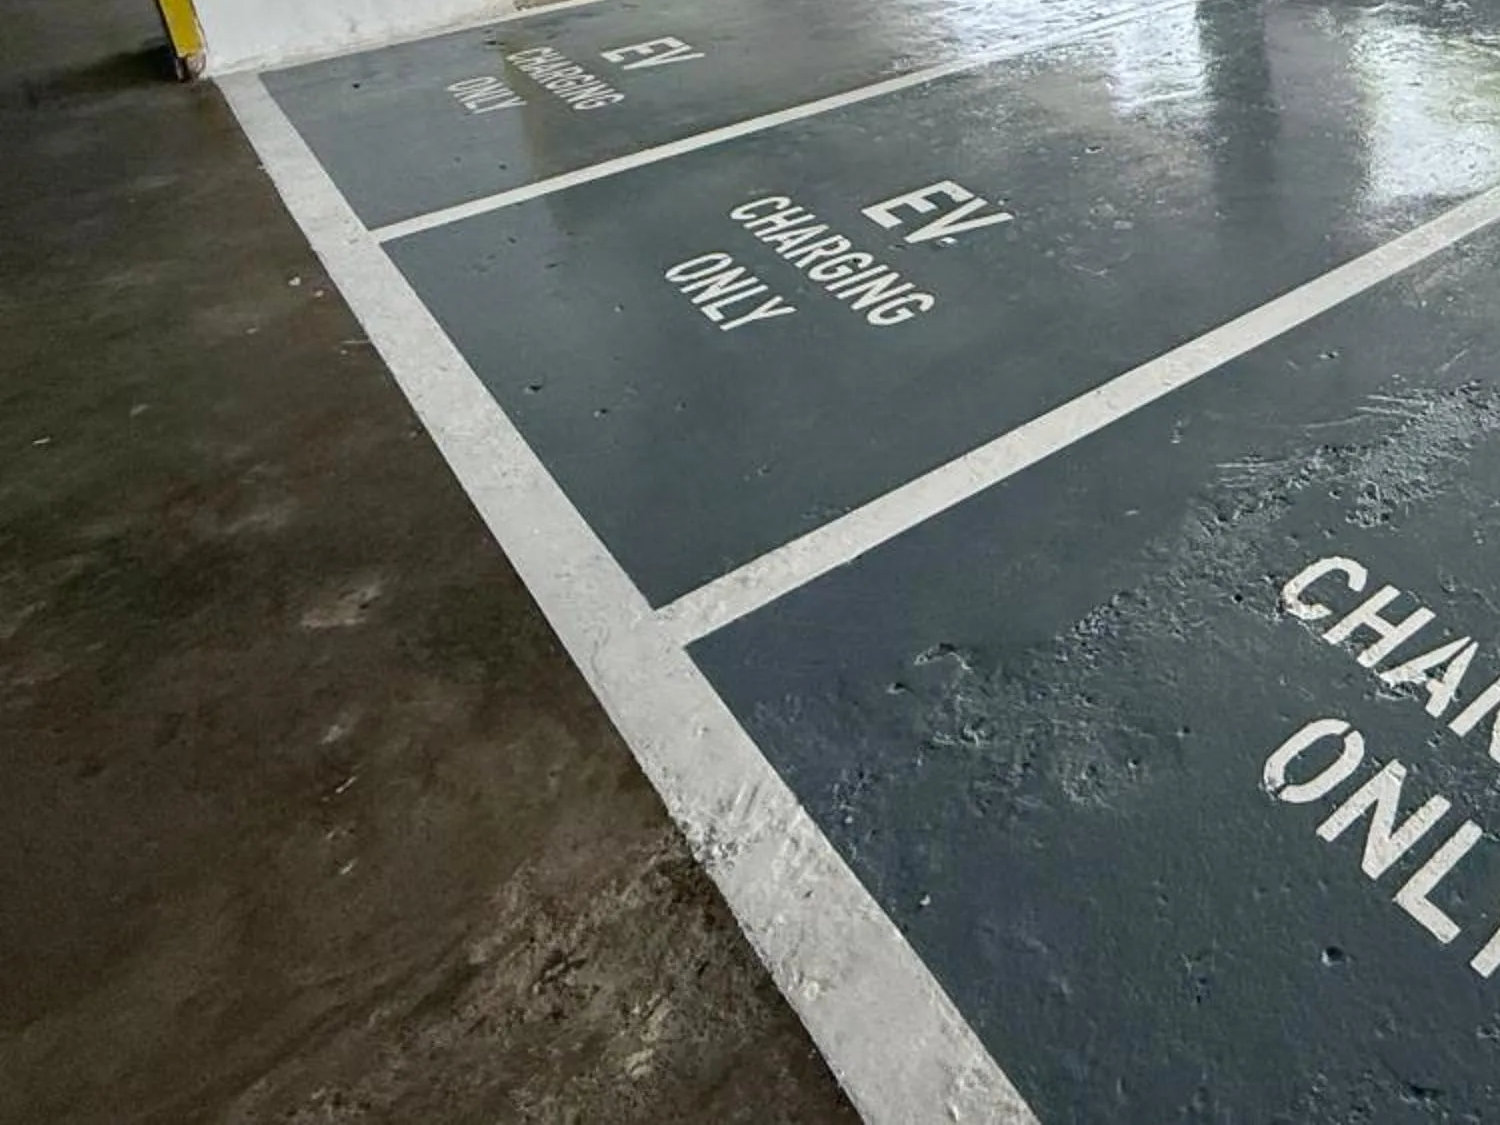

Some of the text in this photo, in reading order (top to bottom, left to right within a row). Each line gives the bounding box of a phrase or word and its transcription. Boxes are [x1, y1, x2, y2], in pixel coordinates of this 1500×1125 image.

[507, 47, 625, 110] CHARGING
[601, 37, 704, 71] EV
[446, 76, 527, 115] ONLY
[862, 180, 1013, 244] EV
[664, 252, 796, 331] ONLY
[730, 196, 934, 326] CHARGING
